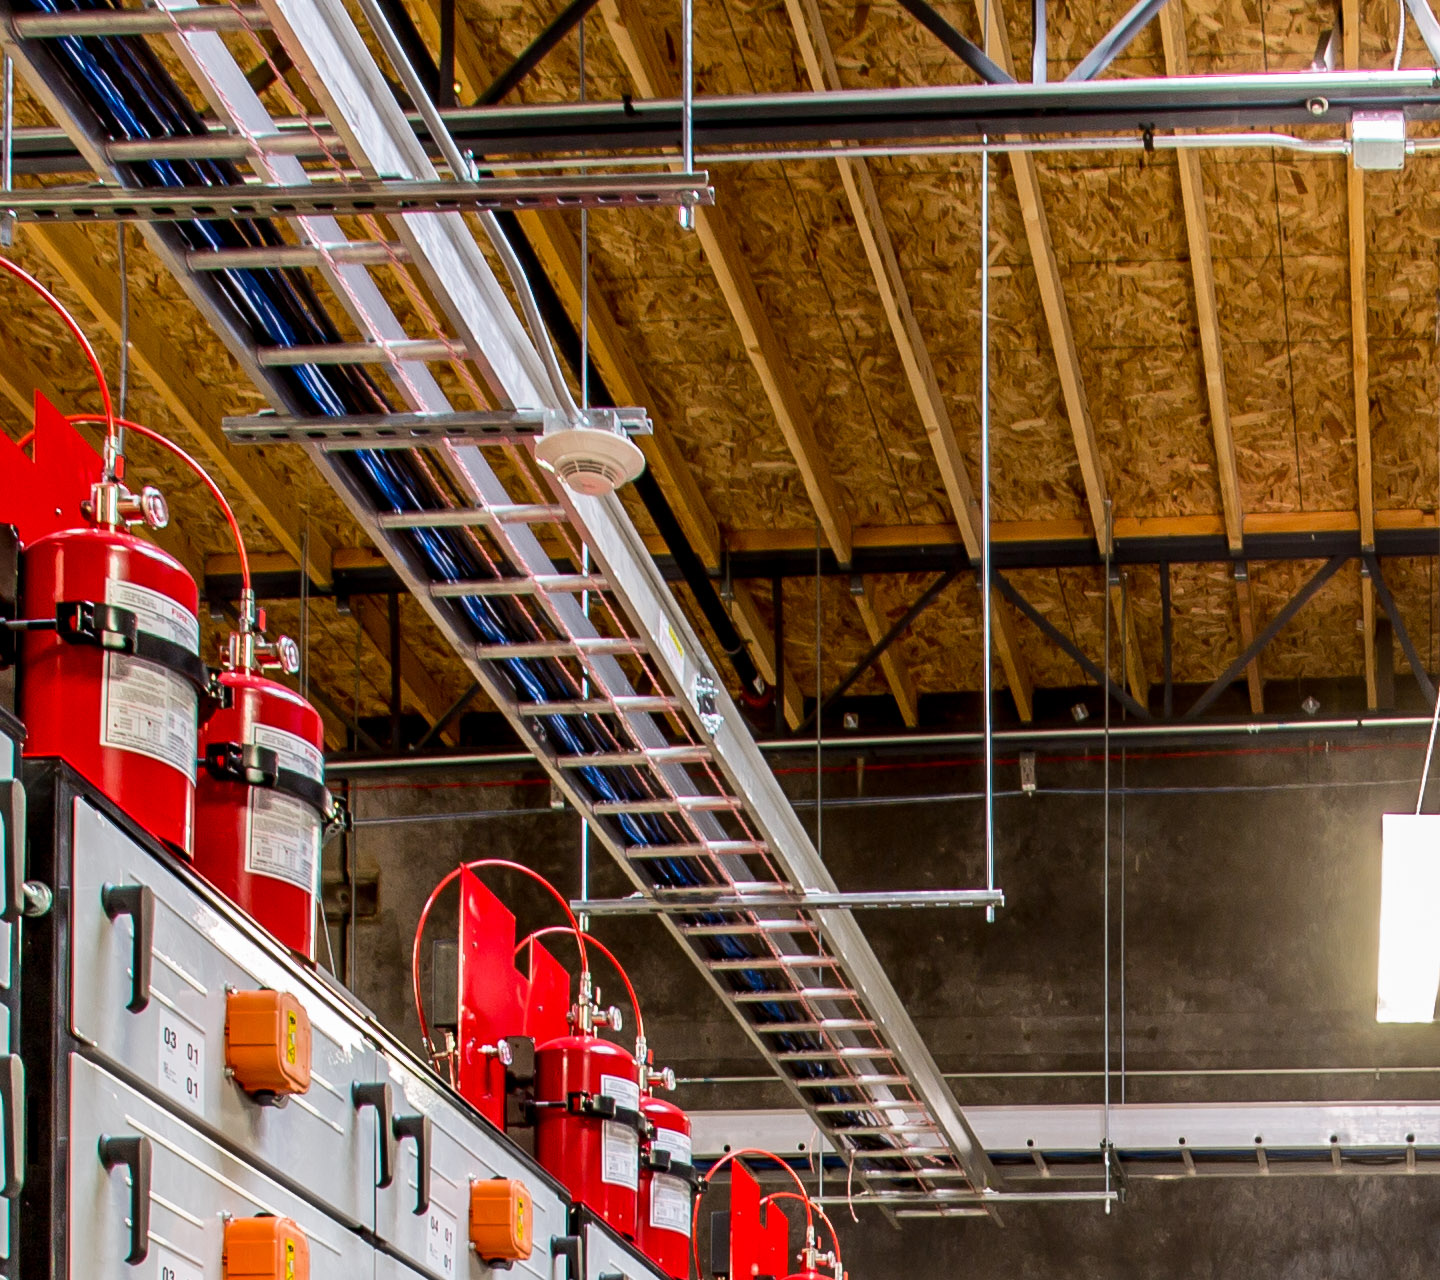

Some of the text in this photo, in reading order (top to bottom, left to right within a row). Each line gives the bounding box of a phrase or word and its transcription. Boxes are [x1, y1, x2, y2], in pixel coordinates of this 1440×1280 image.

[163, 1026, 177, 1049] 03
[187, 1043, 199, 1065] 01
[186, 1076, 198, 1099] 01
